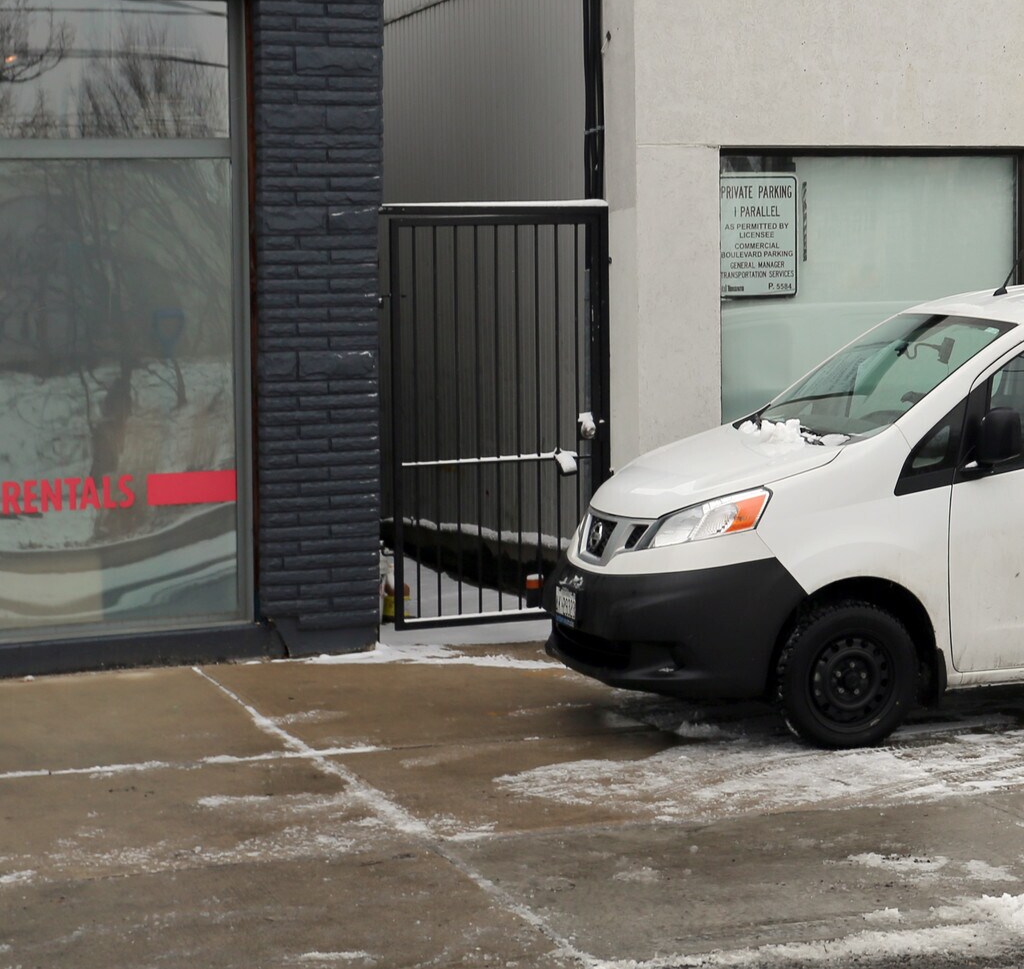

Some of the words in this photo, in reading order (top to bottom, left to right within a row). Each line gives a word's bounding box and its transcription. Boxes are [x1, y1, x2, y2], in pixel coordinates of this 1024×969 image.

[721, 185, 753, 199] PRIVATE
[758, 185, 792, 199] PARKING
[740, 205, 780, 217] PARALLEL
[730, 261, 755, 269] GENERAL
[1, 474, 136, 515] RENTALS
